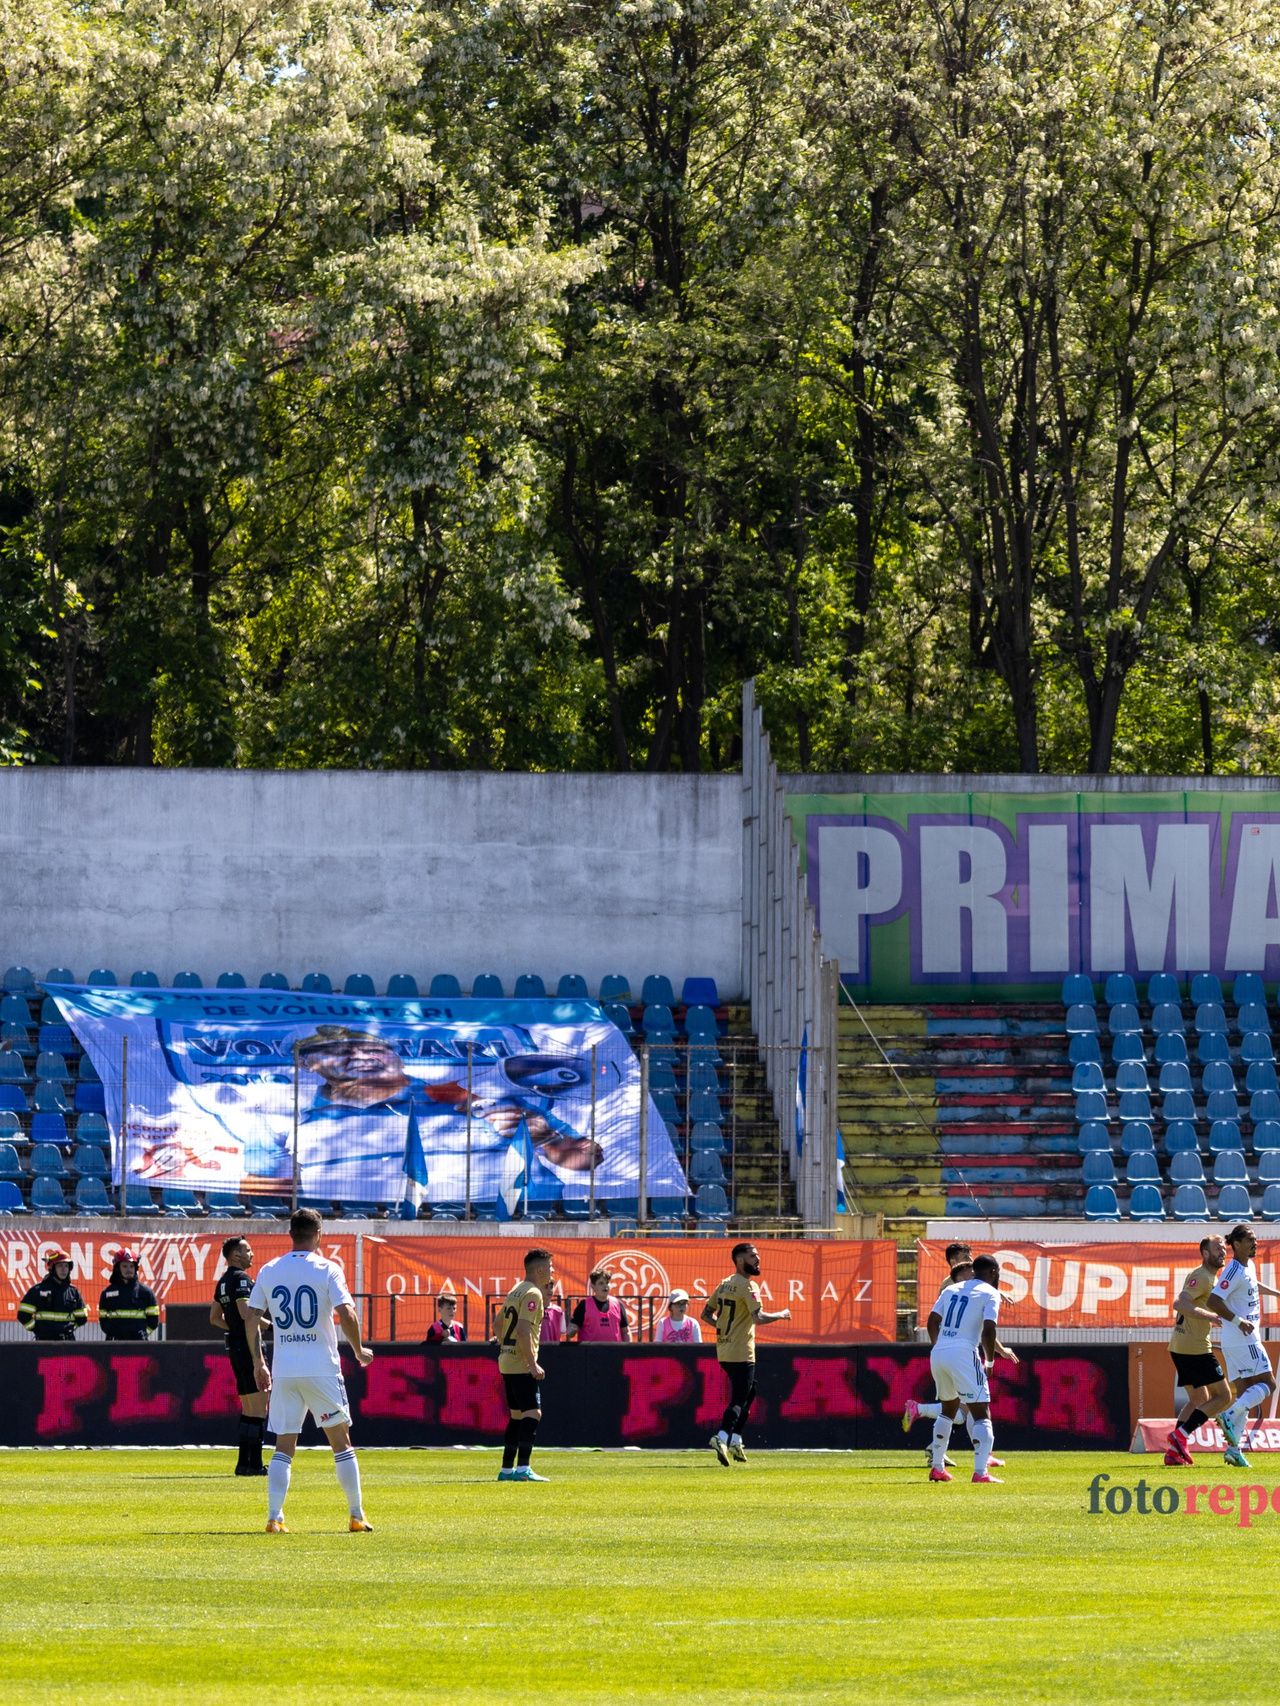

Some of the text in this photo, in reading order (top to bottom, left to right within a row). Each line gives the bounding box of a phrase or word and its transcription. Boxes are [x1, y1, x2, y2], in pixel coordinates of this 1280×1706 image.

[202, 1004, 454, 1019] DE VOLUNTARI
[386, 1274, 873, 1302] QUANTM SARAZ
[272, 1285, 318, 1330] 30
[944, 1294, 969, 1329] 11
